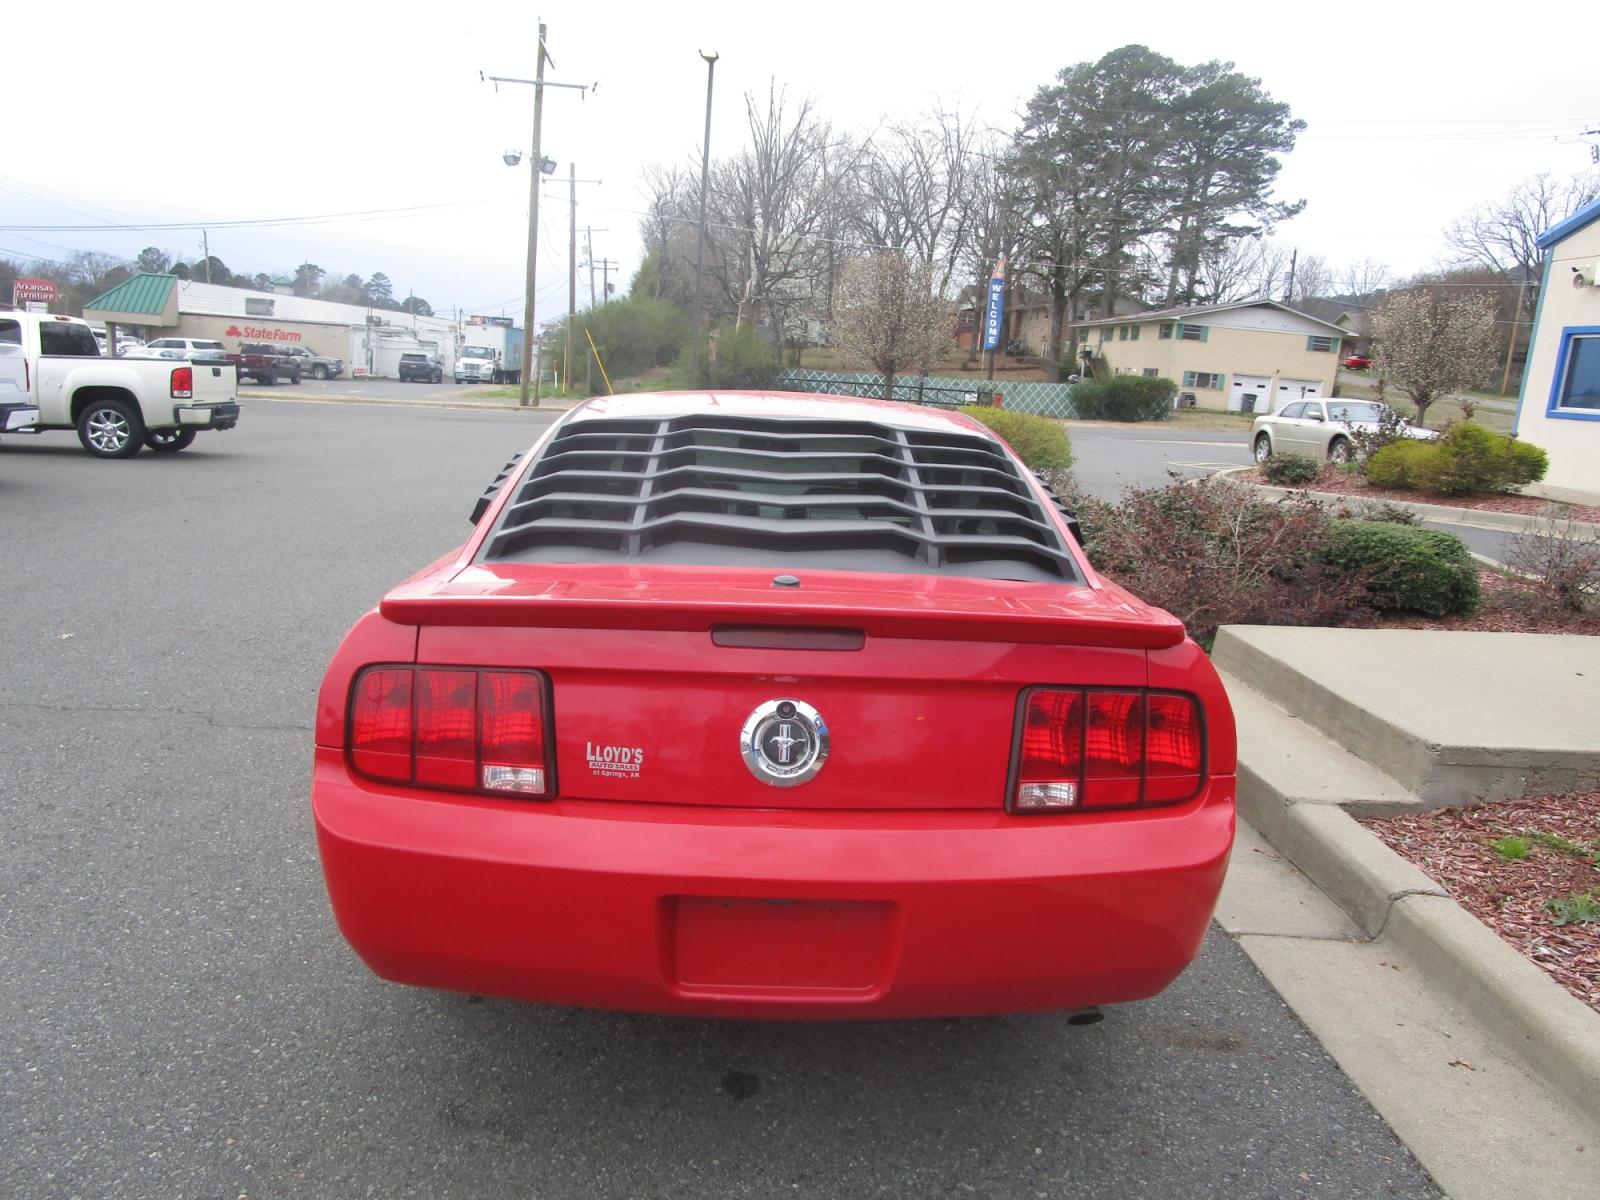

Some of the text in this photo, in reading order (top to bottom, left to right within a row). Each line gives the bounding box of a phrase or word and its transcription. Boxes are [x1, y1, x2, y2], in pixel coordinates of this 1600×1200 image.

[16, 282, 54, 292] Arkansas
[16, 290, 54, 300] Furniture
[988, 283, 1002, 344] WELCOME
[586, 741, 644, 764] LLOYD'S
[615, 763, 639, 771] SALES
